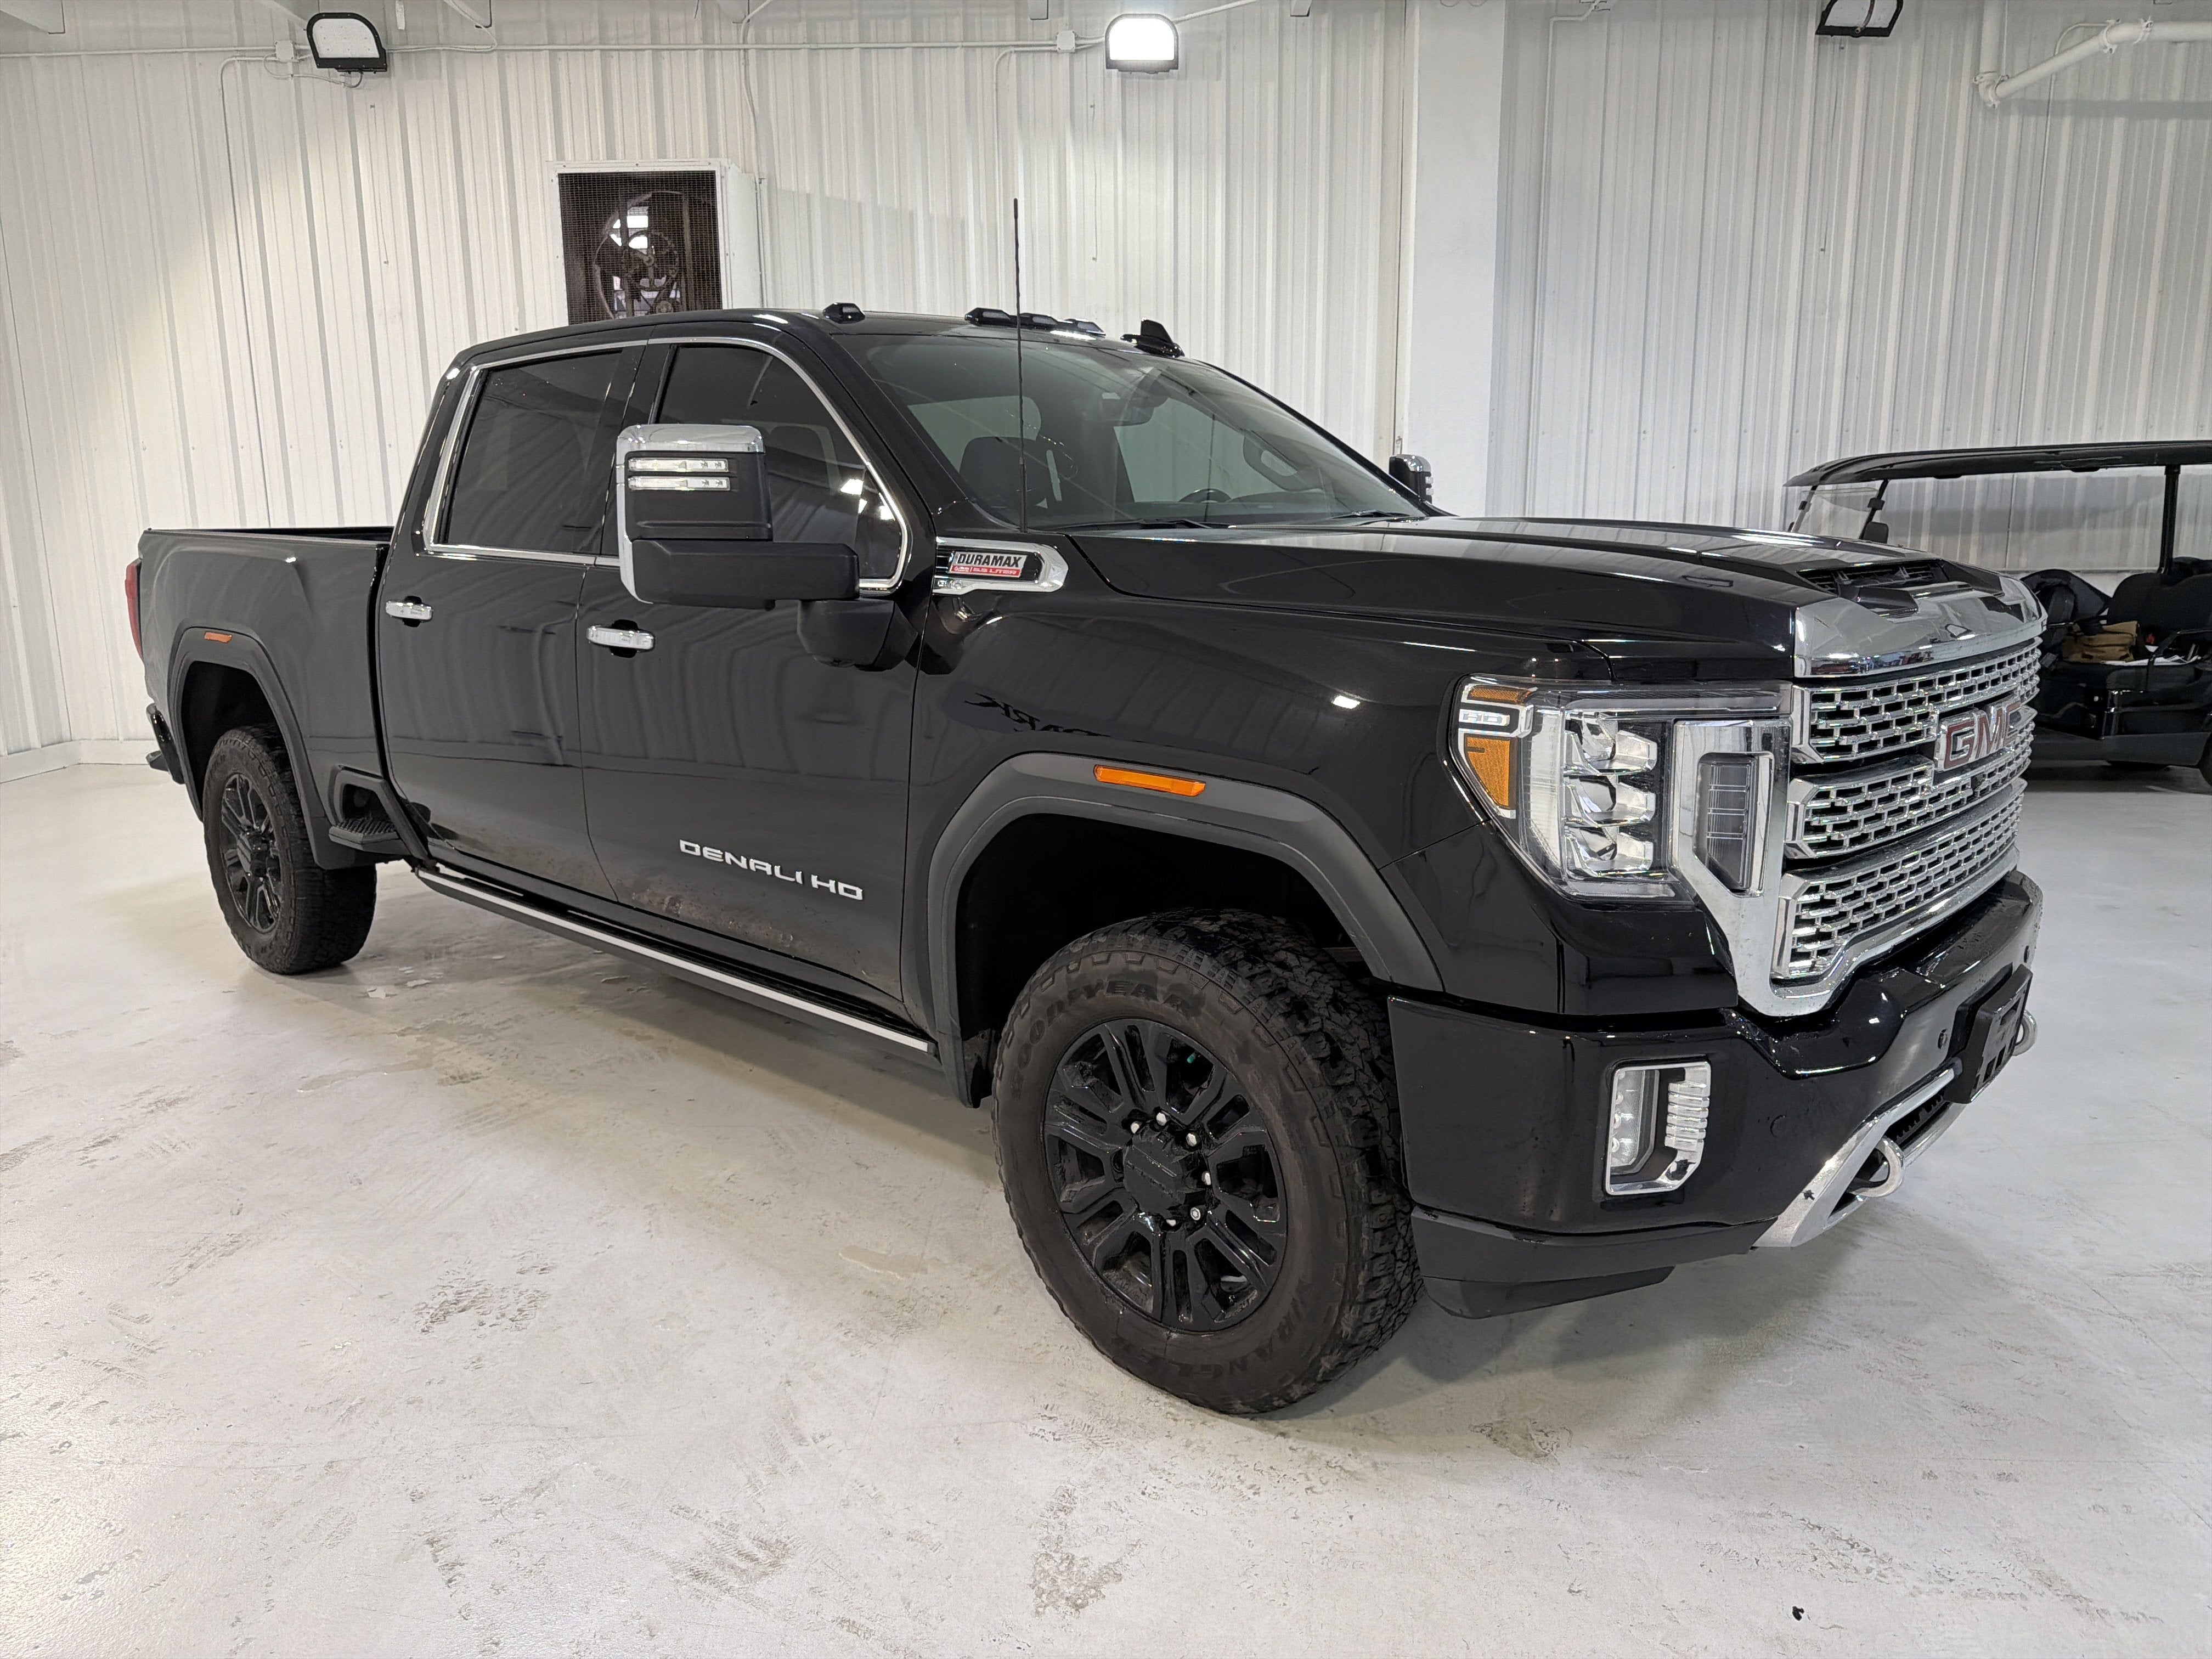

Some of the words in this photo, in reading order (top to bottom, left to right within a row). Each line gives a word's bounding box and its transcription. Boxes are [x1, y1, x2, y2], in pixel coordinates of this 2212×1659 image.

[957, 554, 1023, 568] DURAMAX
[1943, 700, 2022, 771] GMC
[680, 839, 803, 885] DENALI
[811, 874, 864, 901] HD
[1011, 979, 1188, 1099] GOODYEAR
